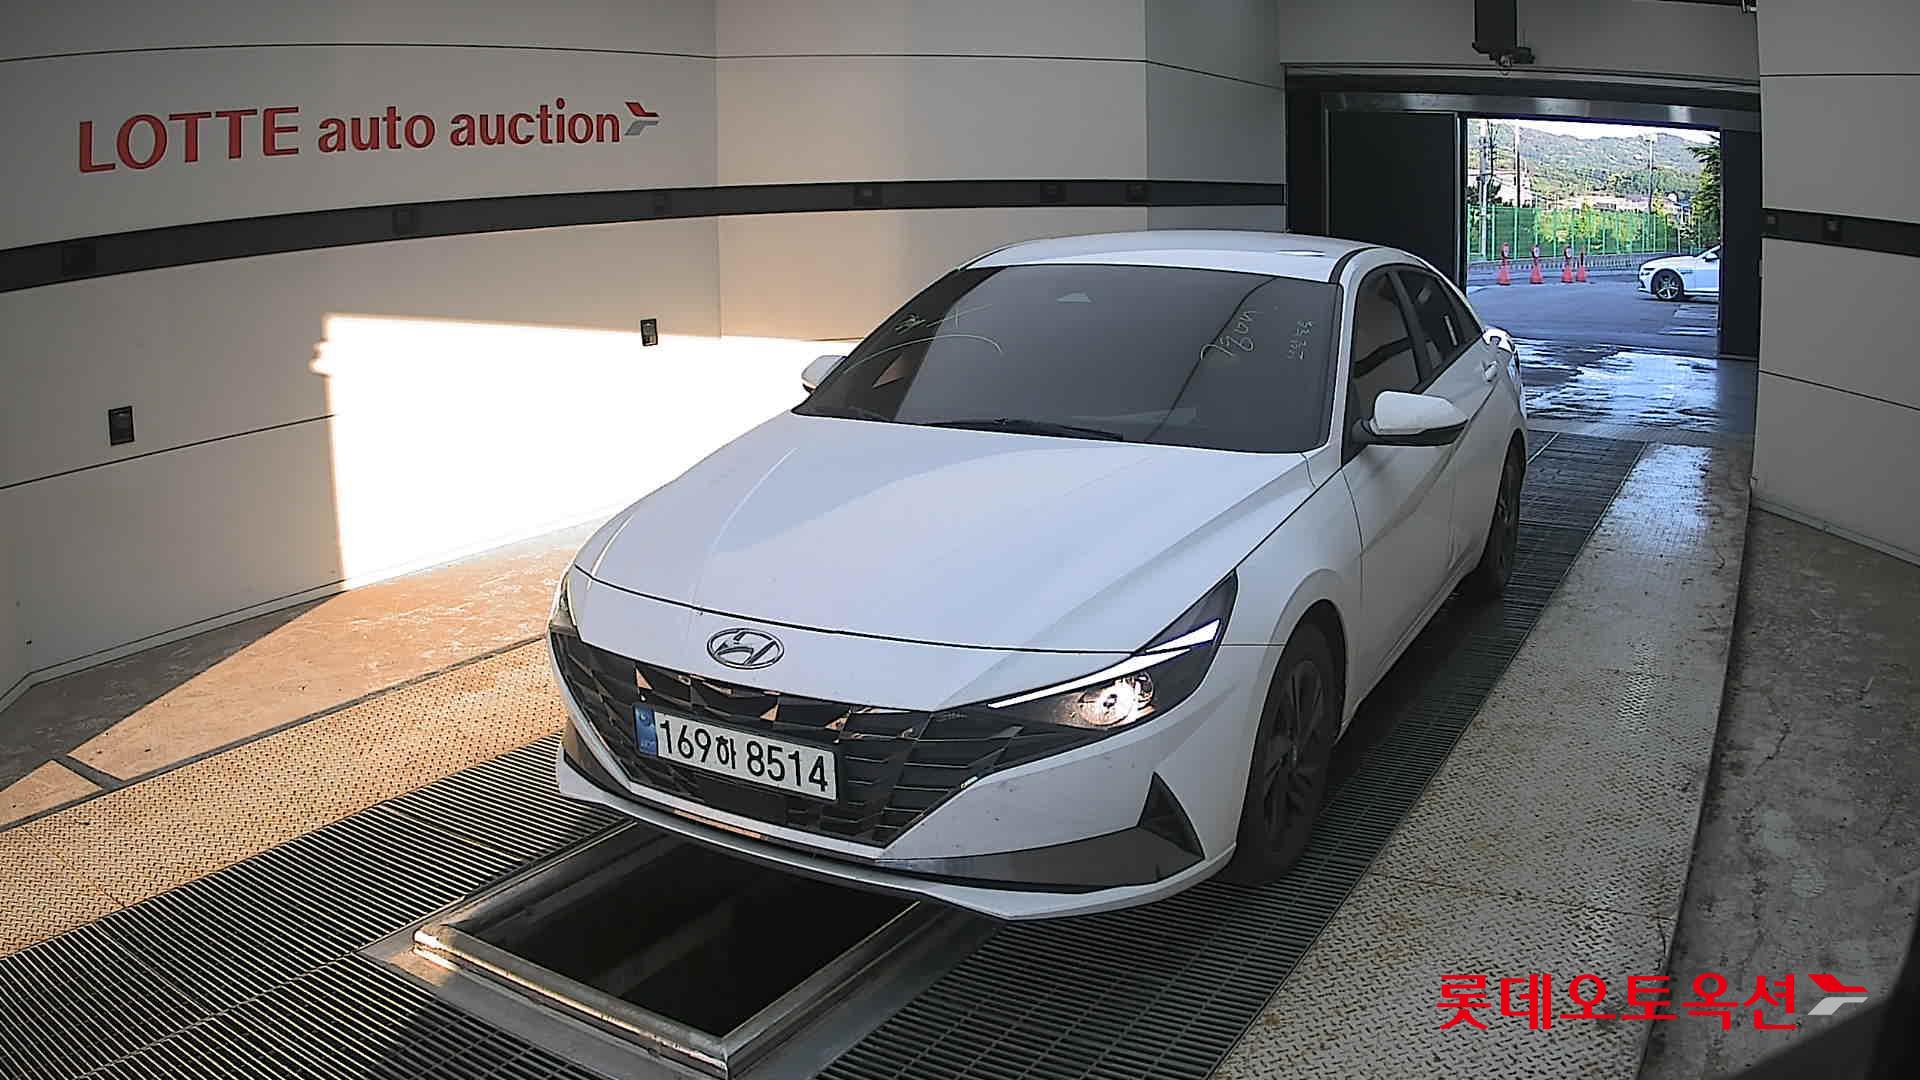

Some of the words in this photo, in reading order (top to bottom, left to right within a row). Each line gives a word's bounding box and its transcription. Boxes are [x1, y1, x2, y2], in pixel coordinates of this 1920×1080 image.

[79, 106, 300, 173] LOTTE
[318, 106, 436, 153] auto
[449, 98, 621, 146] auction
[659, 719, 737, 770] 169하
[746, 740, 829, 792] 8514
